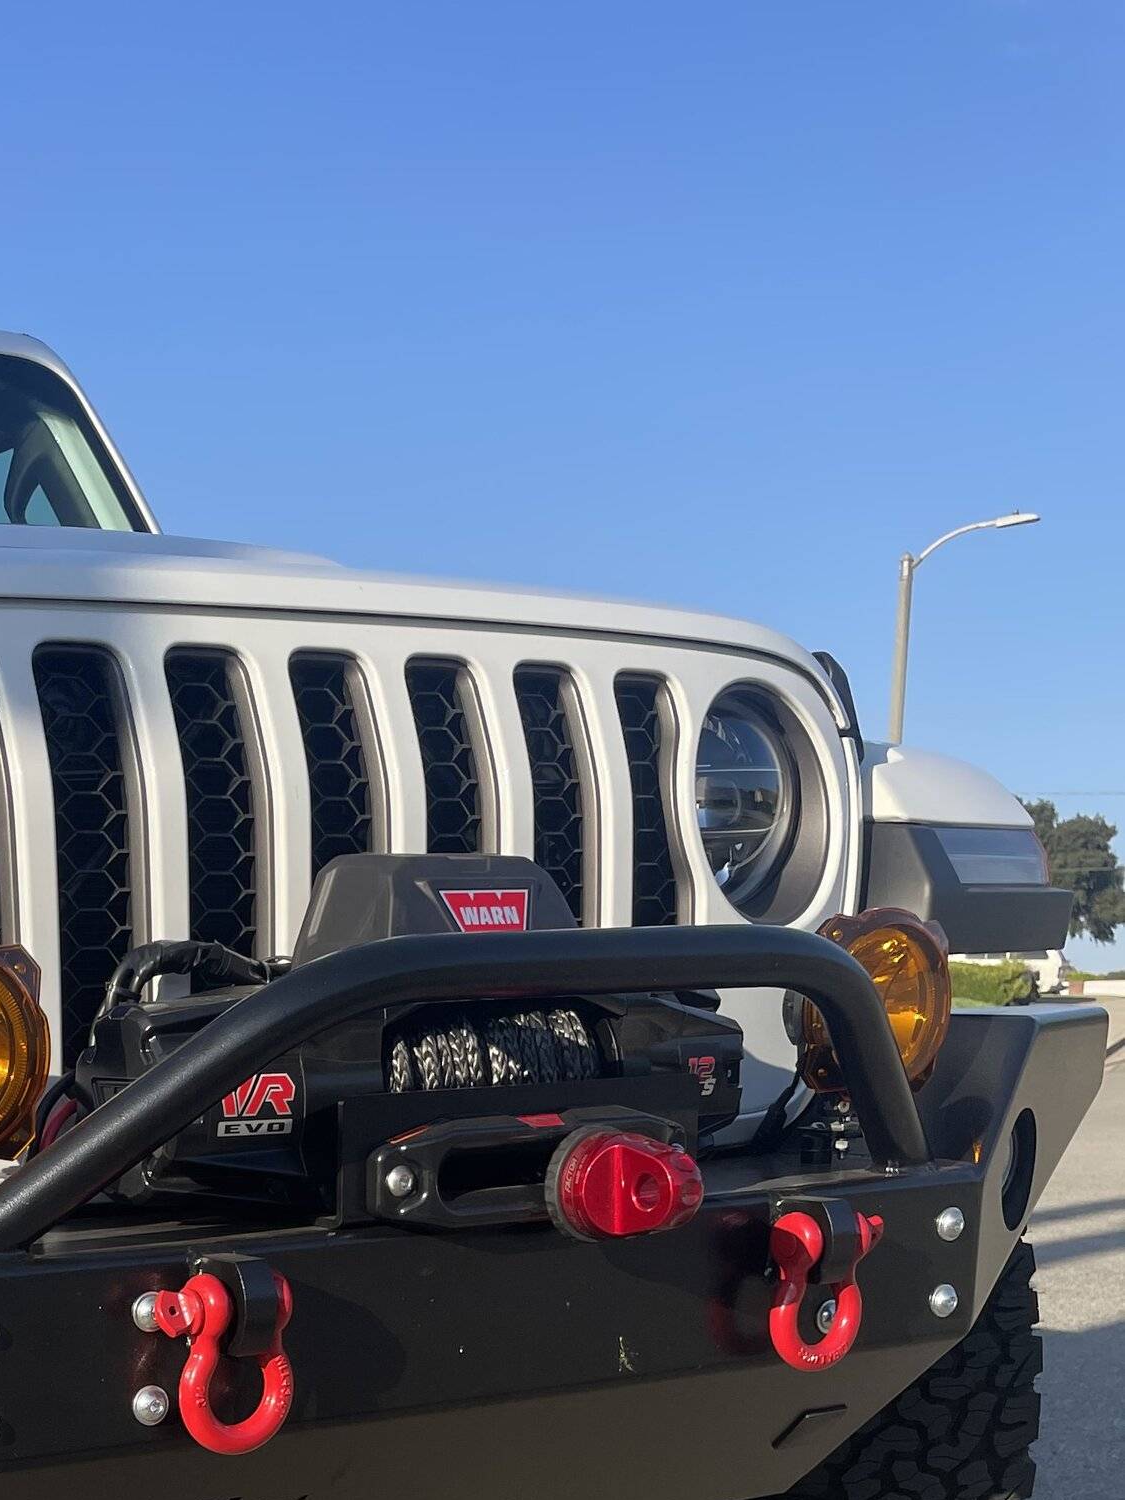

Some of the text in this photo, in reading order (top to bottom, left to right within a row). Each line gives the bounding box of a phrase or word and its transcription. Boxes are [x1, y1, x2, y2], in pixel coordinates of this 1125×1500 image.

[459, 905, 520, 926] WARN
[688, 1056, 716, 1084] 12
[224, 1121, 286, 1135] EVO
